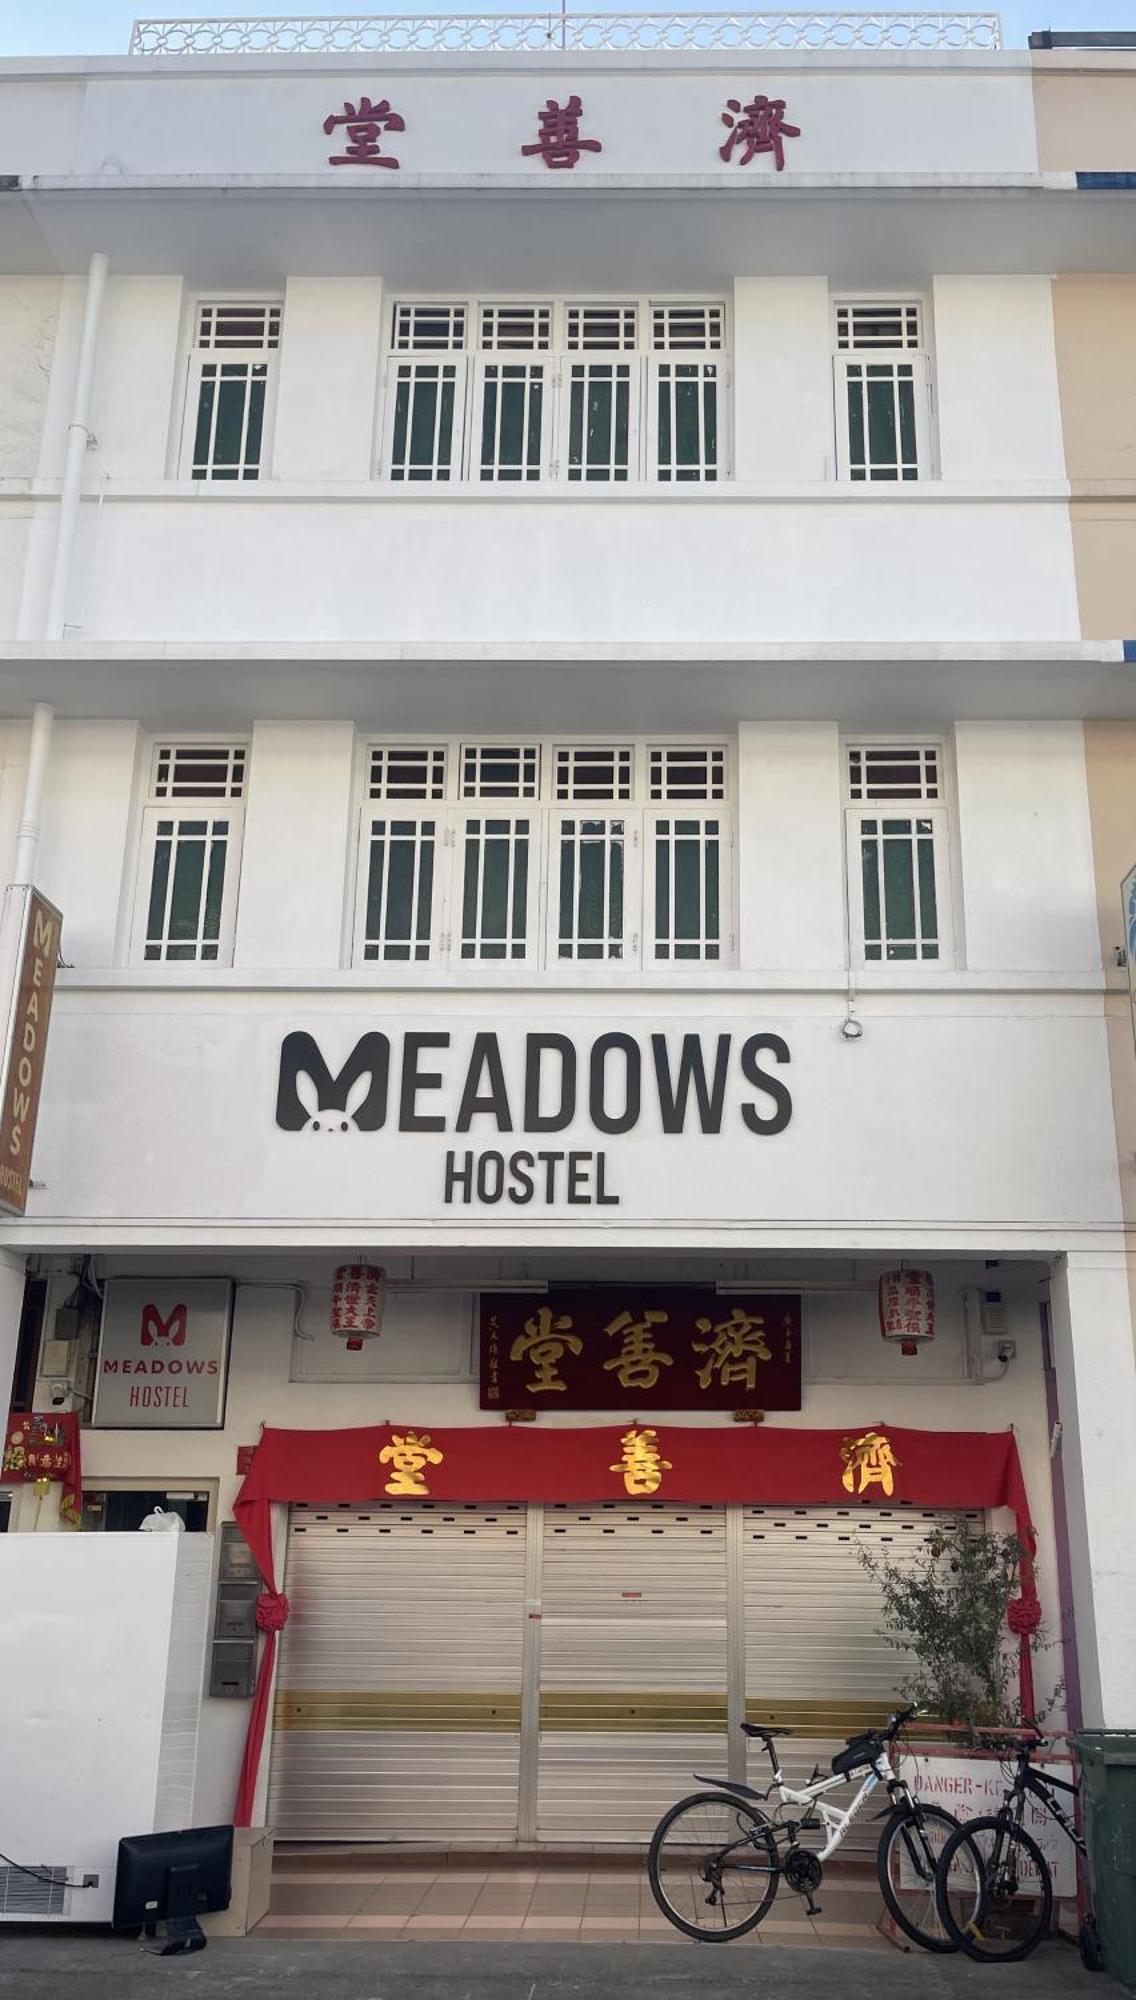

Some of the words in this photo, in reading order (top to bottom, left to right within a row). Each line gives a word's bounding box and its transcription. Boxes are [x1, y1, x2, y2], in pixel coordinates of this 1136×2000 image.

[10, 909, 53, 1157] MEADOWS
[275, 1030, 793, 1136] MEADOWS
[445, 1150, 620, 1205] HOSTEL
[103, 1360, 219, 1375] MEADOWS
[129, 1386, 190, 1408] HOSTEL
